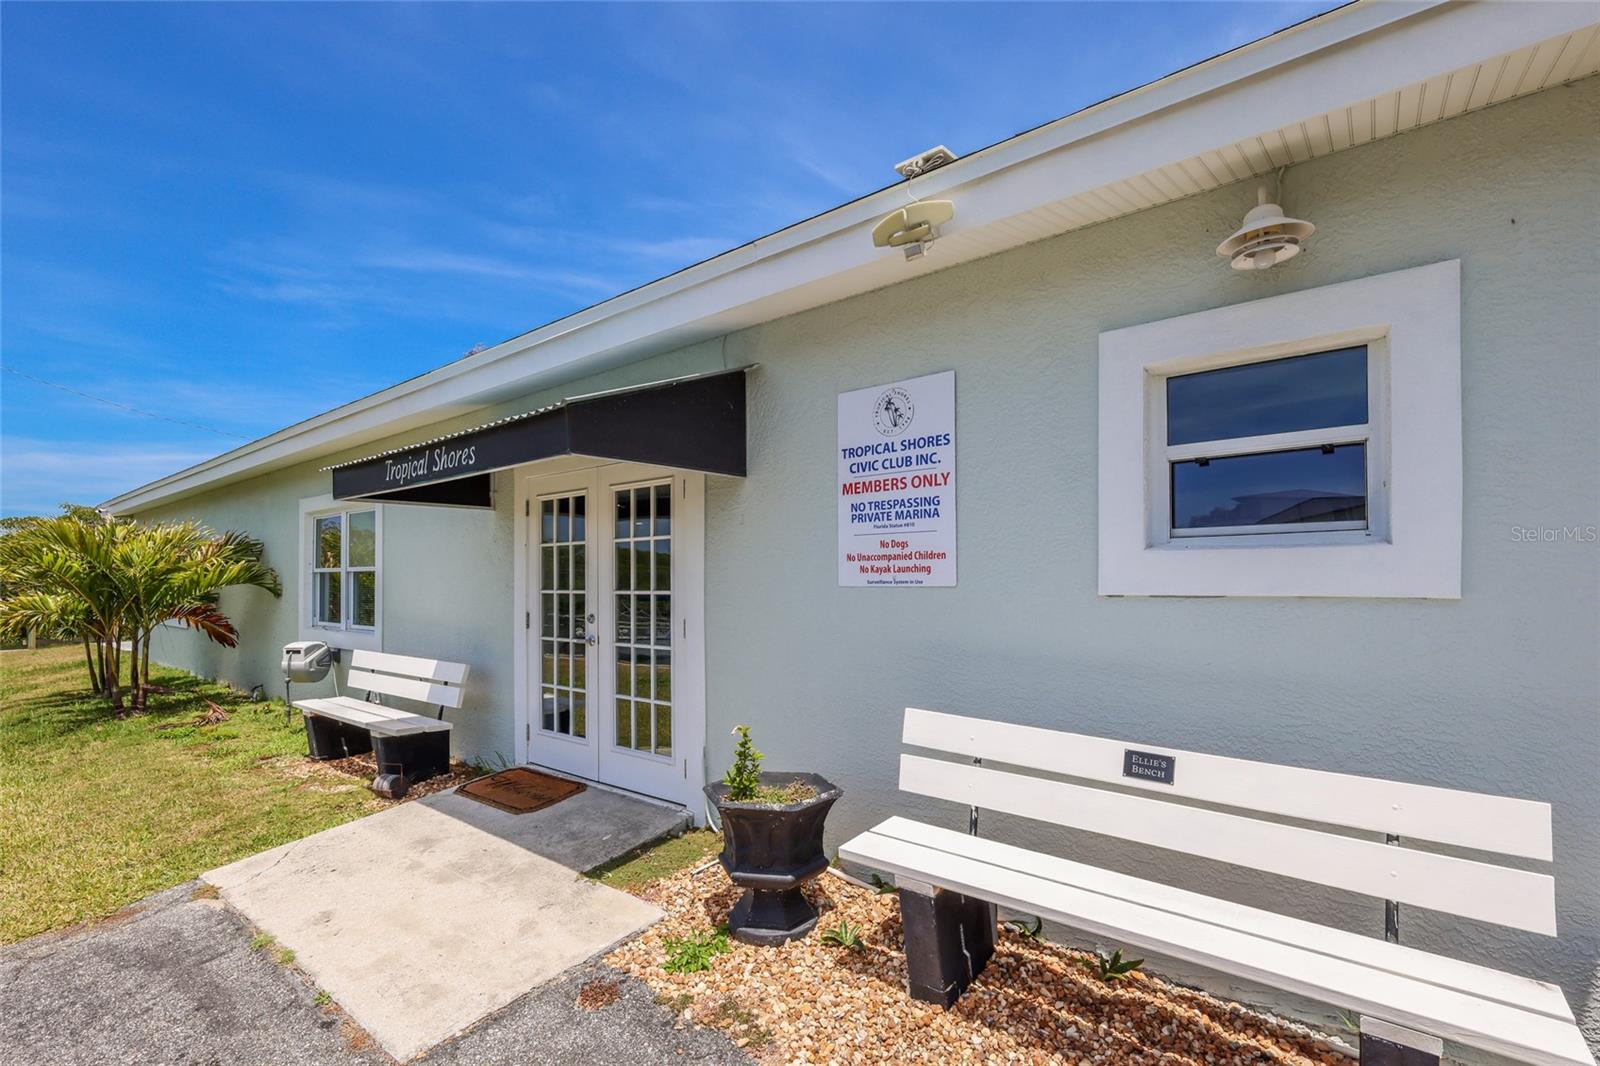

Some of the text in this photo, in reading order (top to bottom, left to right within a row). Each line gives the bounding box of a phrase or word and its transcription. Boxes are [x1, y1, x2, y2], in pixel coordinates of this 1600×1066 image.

[841, 433, 951, 459] TROPICAL SHORES
[385, 446, 475, 484] Tropical Shores
[849, 452, 942, 474] CIVIC CLUB INC.
[842, 472, 951, 496] MEMBERS ONLY
[850, 495, 940, 513] NO TRESPASSING
[851, 507, 940, 524] PRIVATE MARINA
[880, 539, 909, 550] No Dogs
[846, 551, 946, 563] No Unaccompanied Children
[859, 564, 932, 575] No Kayak Launching
[1132, 754, 1167, 769] ELLIE'S
[1132, 764, 1165, 778] BENCH
